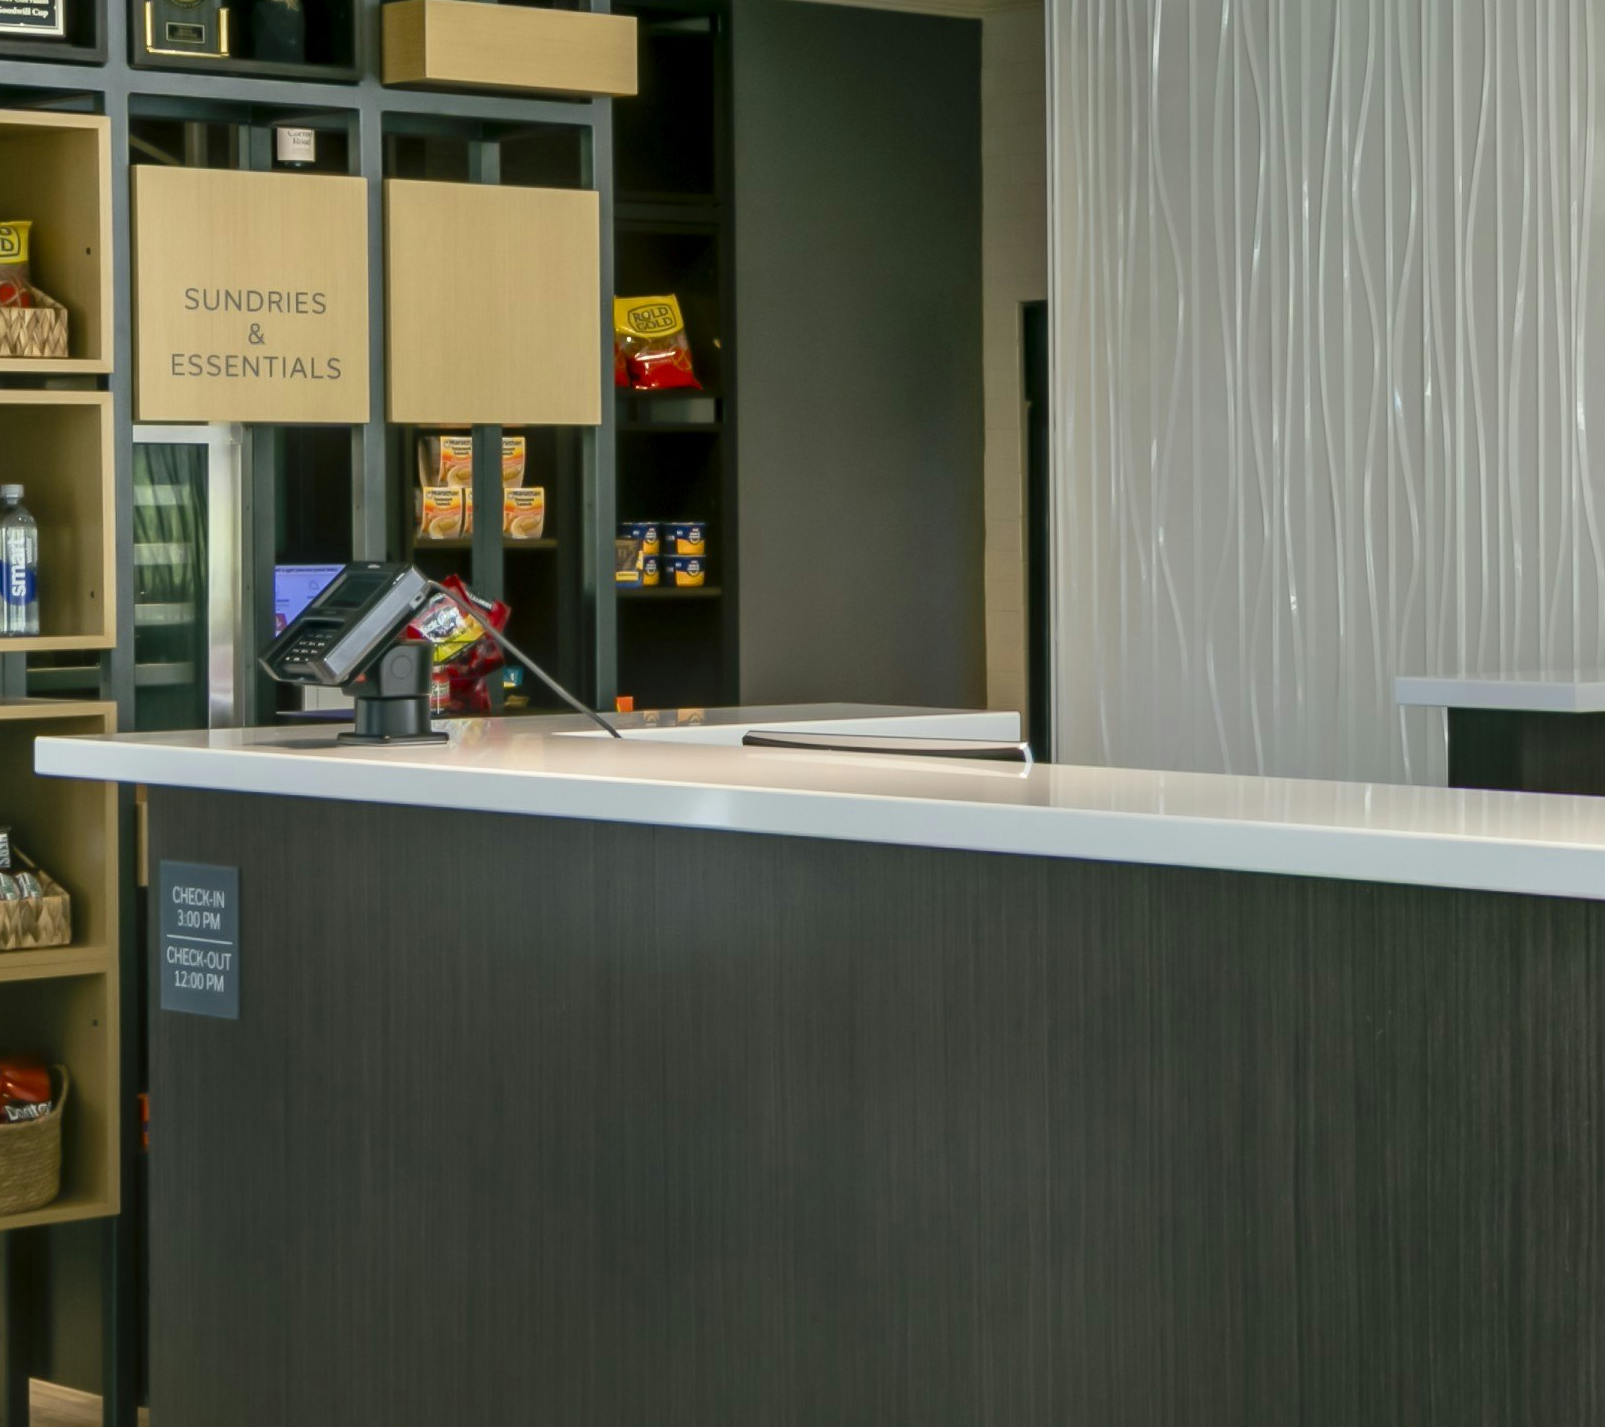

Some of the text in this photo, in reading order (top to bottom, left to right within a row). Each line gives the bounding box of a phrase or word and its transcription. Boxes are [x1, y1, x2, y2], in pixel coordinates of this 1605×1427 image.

[32, 7, 49, 19] Cup
[184, 287, 327, 315] SUNDRIES
[633, 306, 669, 323] ROLD
[635, 317, 673, 331] GOLD
[248, 323, 266, 345] &
[171, 353, 342, 380] ESSENTIALS
[7, 538, 26, 597] smart
[172, 885, 225, 909] CHECK-IN
[177, 909, 221, 930] 3:00 PM
[166, 945, 232, 971] CHECK-OUT
[174, 970, 225, 993] 12:00 PM
